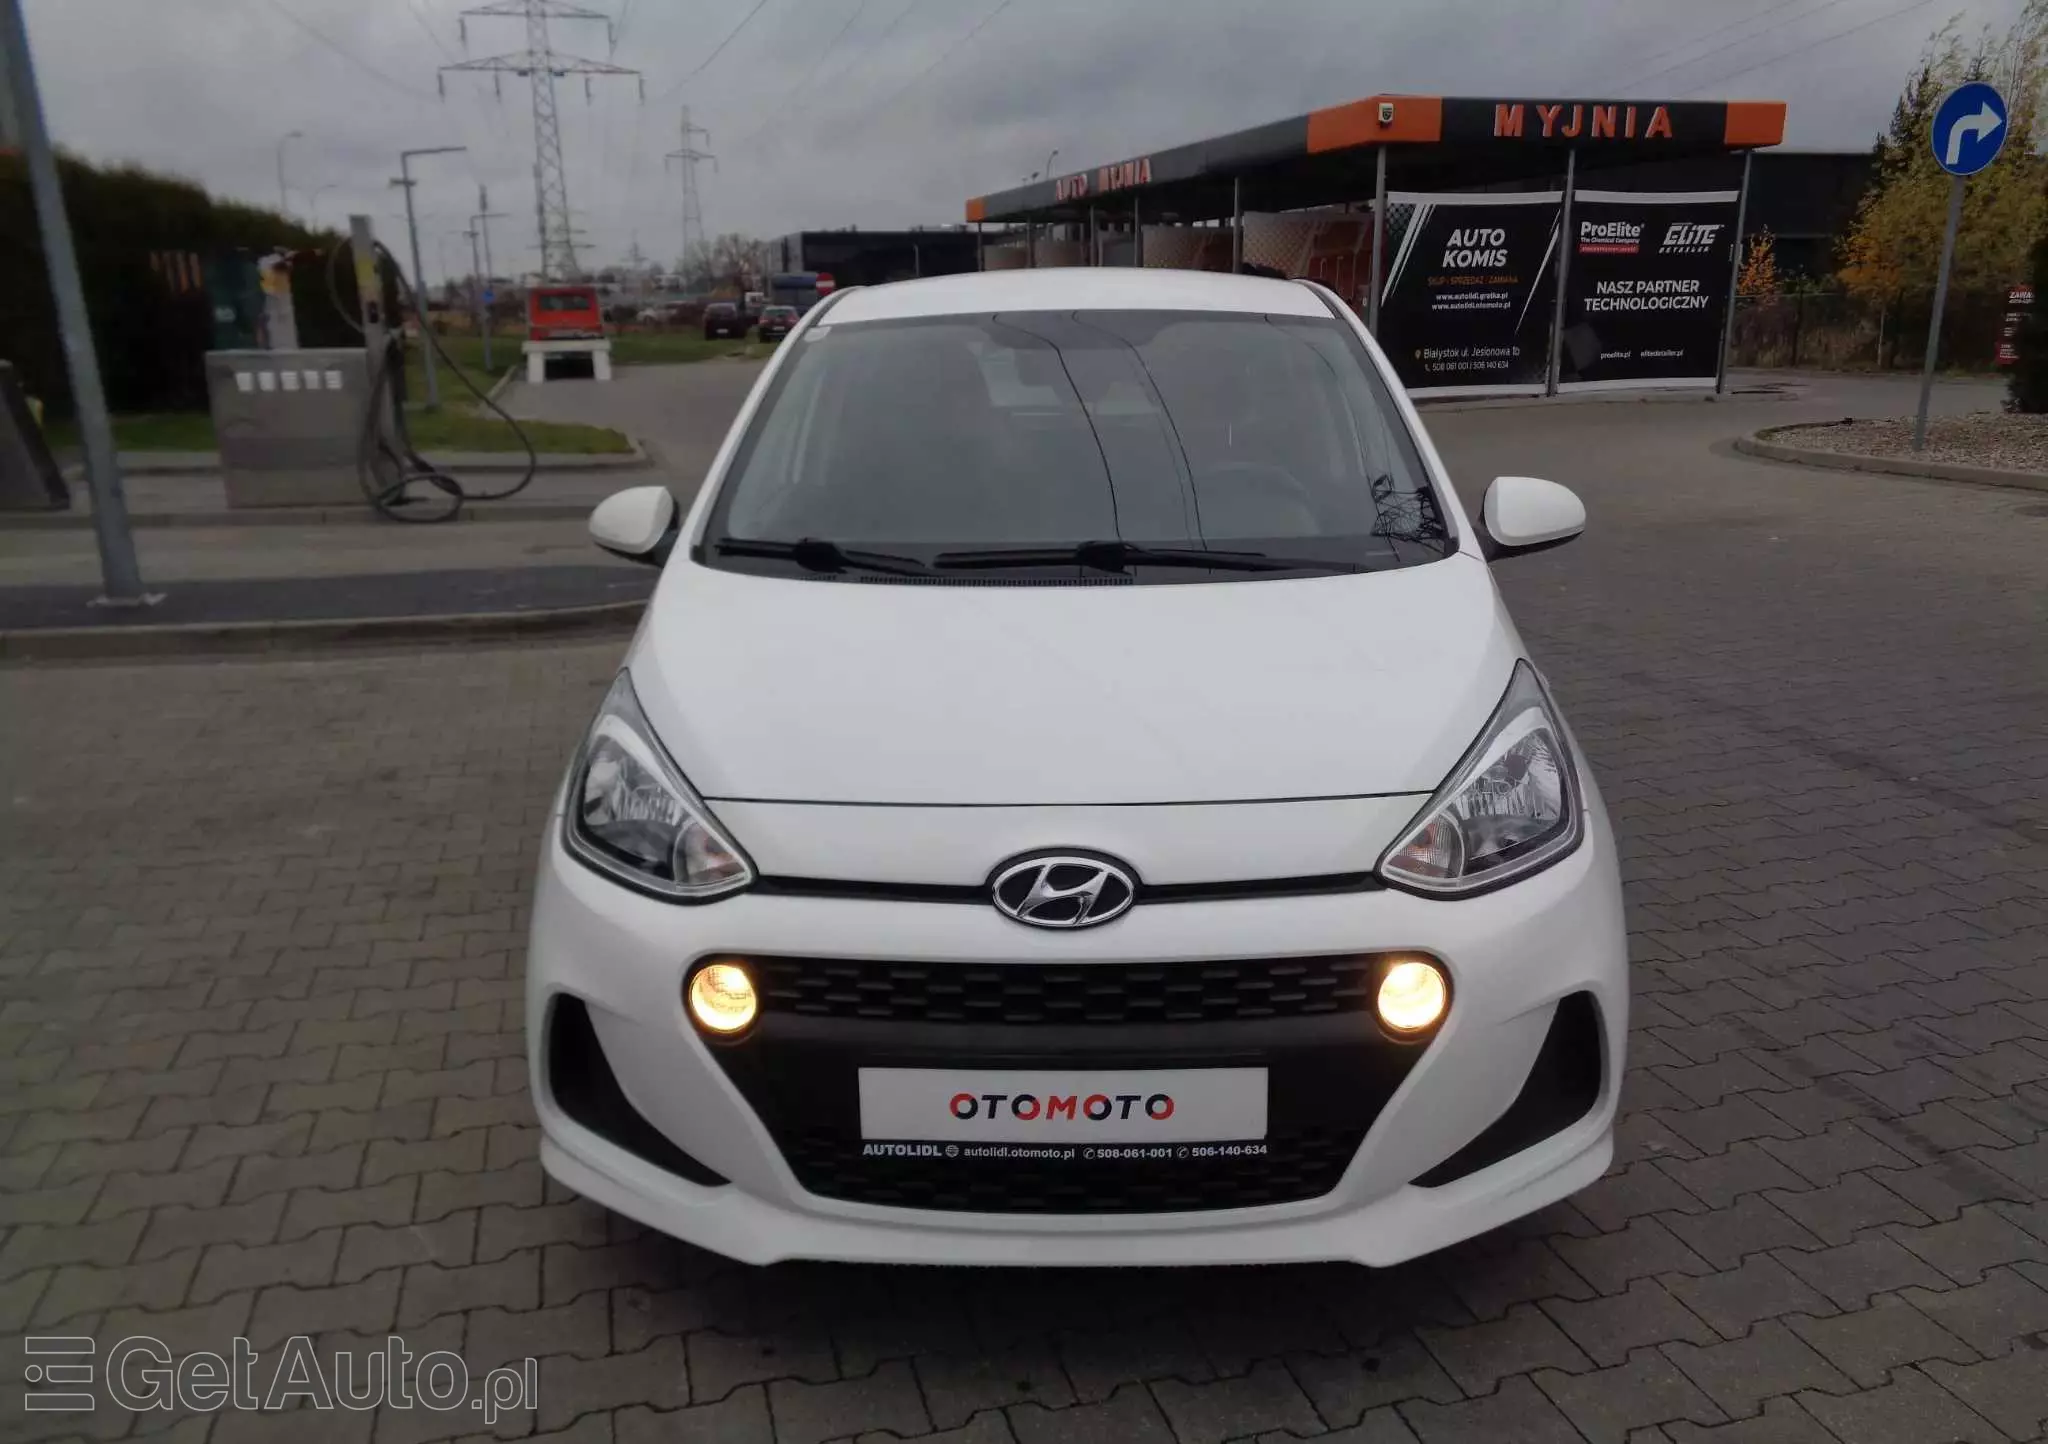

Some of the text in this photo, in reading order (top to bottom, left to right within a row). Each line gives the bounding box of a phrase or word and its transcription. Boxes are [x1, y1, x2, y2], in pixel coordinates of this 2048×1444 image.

[1494, 104, 1673, 139] MYJNIA
[1447, 228, 1506, 247] AUTO
[1581, 222, 1641, 237] ProElite
[1442, 248, 1509, 268] KOMIS
[1597, 279, 1700, 294] NASZ PARTNER
[1584, 295, 1709, 311] TECHNOLOGICZNY
[949, 1092, 1175, 1121] OTOMOTO
[862, 1144, 1268, 1160] AUTOLIDL autolidl.otomoto.pl 508-061-001 506-140-634
